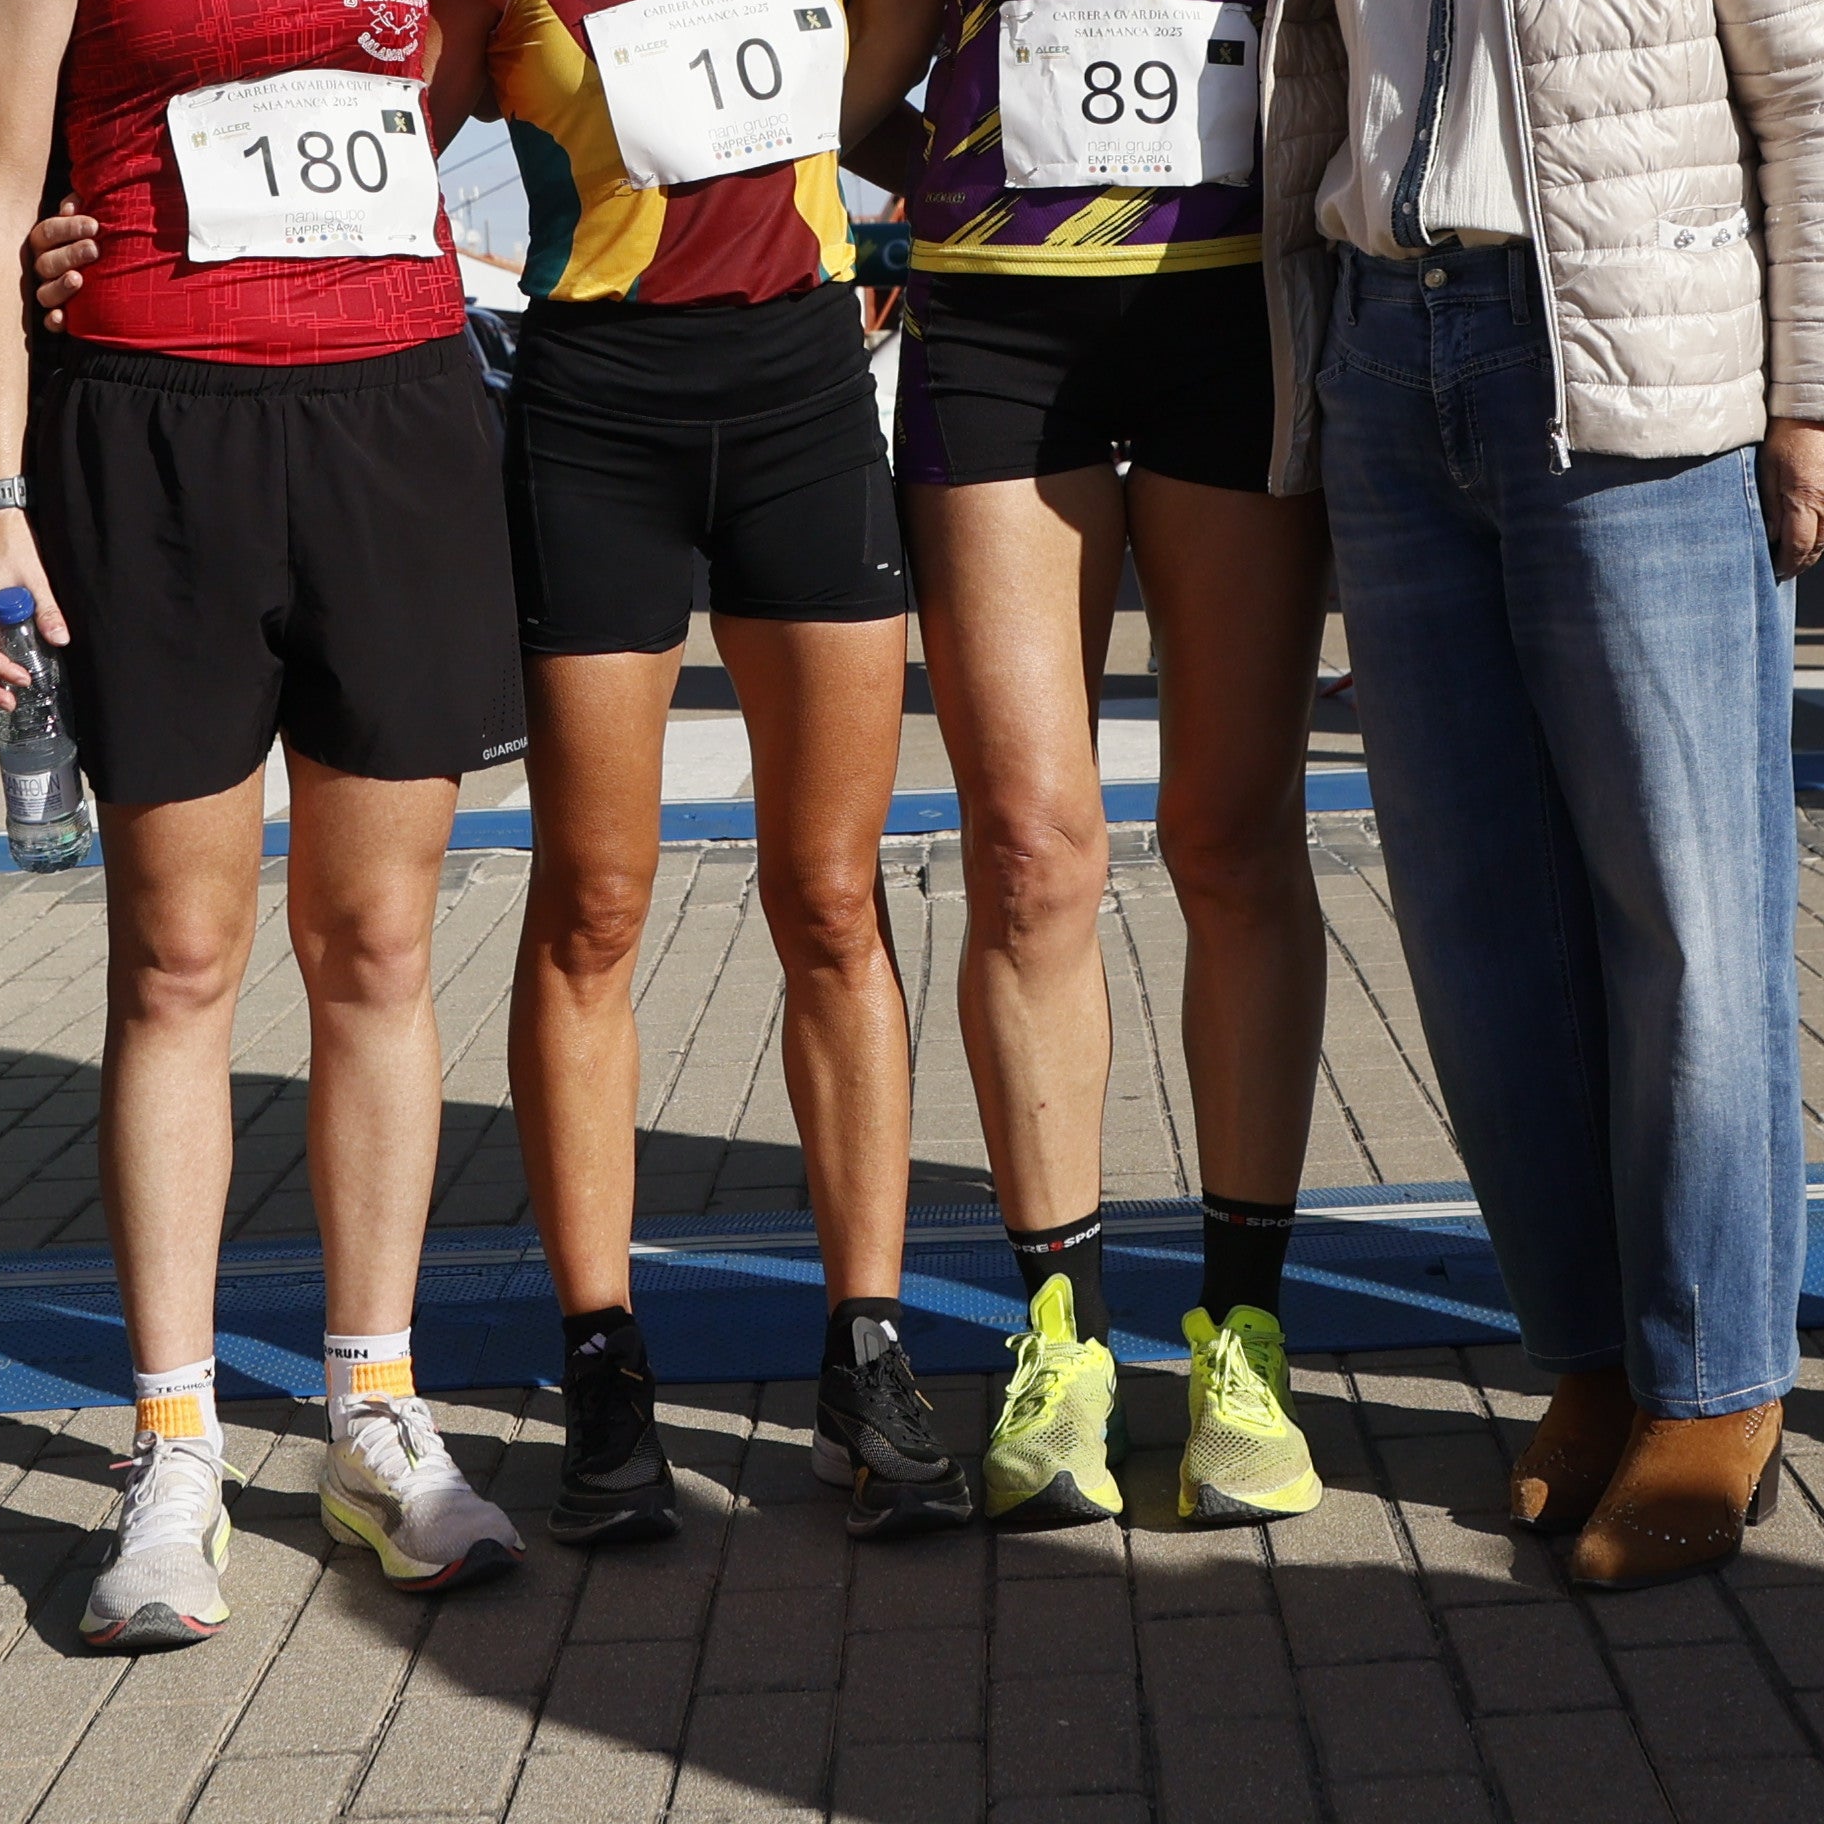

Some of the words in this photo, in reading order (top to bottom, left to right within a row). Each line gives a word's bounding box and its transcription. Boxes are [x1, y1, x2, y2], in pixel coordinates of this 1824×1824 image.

[667, 8, 740, 29] SALAMANCA
[743, 2, 770, 15] 2025
[1053, 9, 1111, 22] CARRERA
[1074, 26, 1149, 38] SALAMANCA
[1153, 26, 1183, 38] 2025
[688, 37, 783, 110] 10
[227, 82, 289, 103] CARRERA
[1081, 60, 1178, 125] 89
[253, 97, 328, 113] SALAMANCA
[332, 96, 359, 108] 2025
[708, 121, 739, 140] nani
[743, 112, 789, 135] grupo
[711, 127, 792, 152] EMPRESARIAL
[1088, 140, 1120, 152] nani
[1125, 140, 1173, 156] grupo
[243, 129, 388, 197] 180
[1088, 154, 1172, 165] EMPRESARIAL
[285, 210, 319, 223] nani
[324, 208, 366, 225] grupo
[285, 222, 364, 237] EMPRESARIAL
